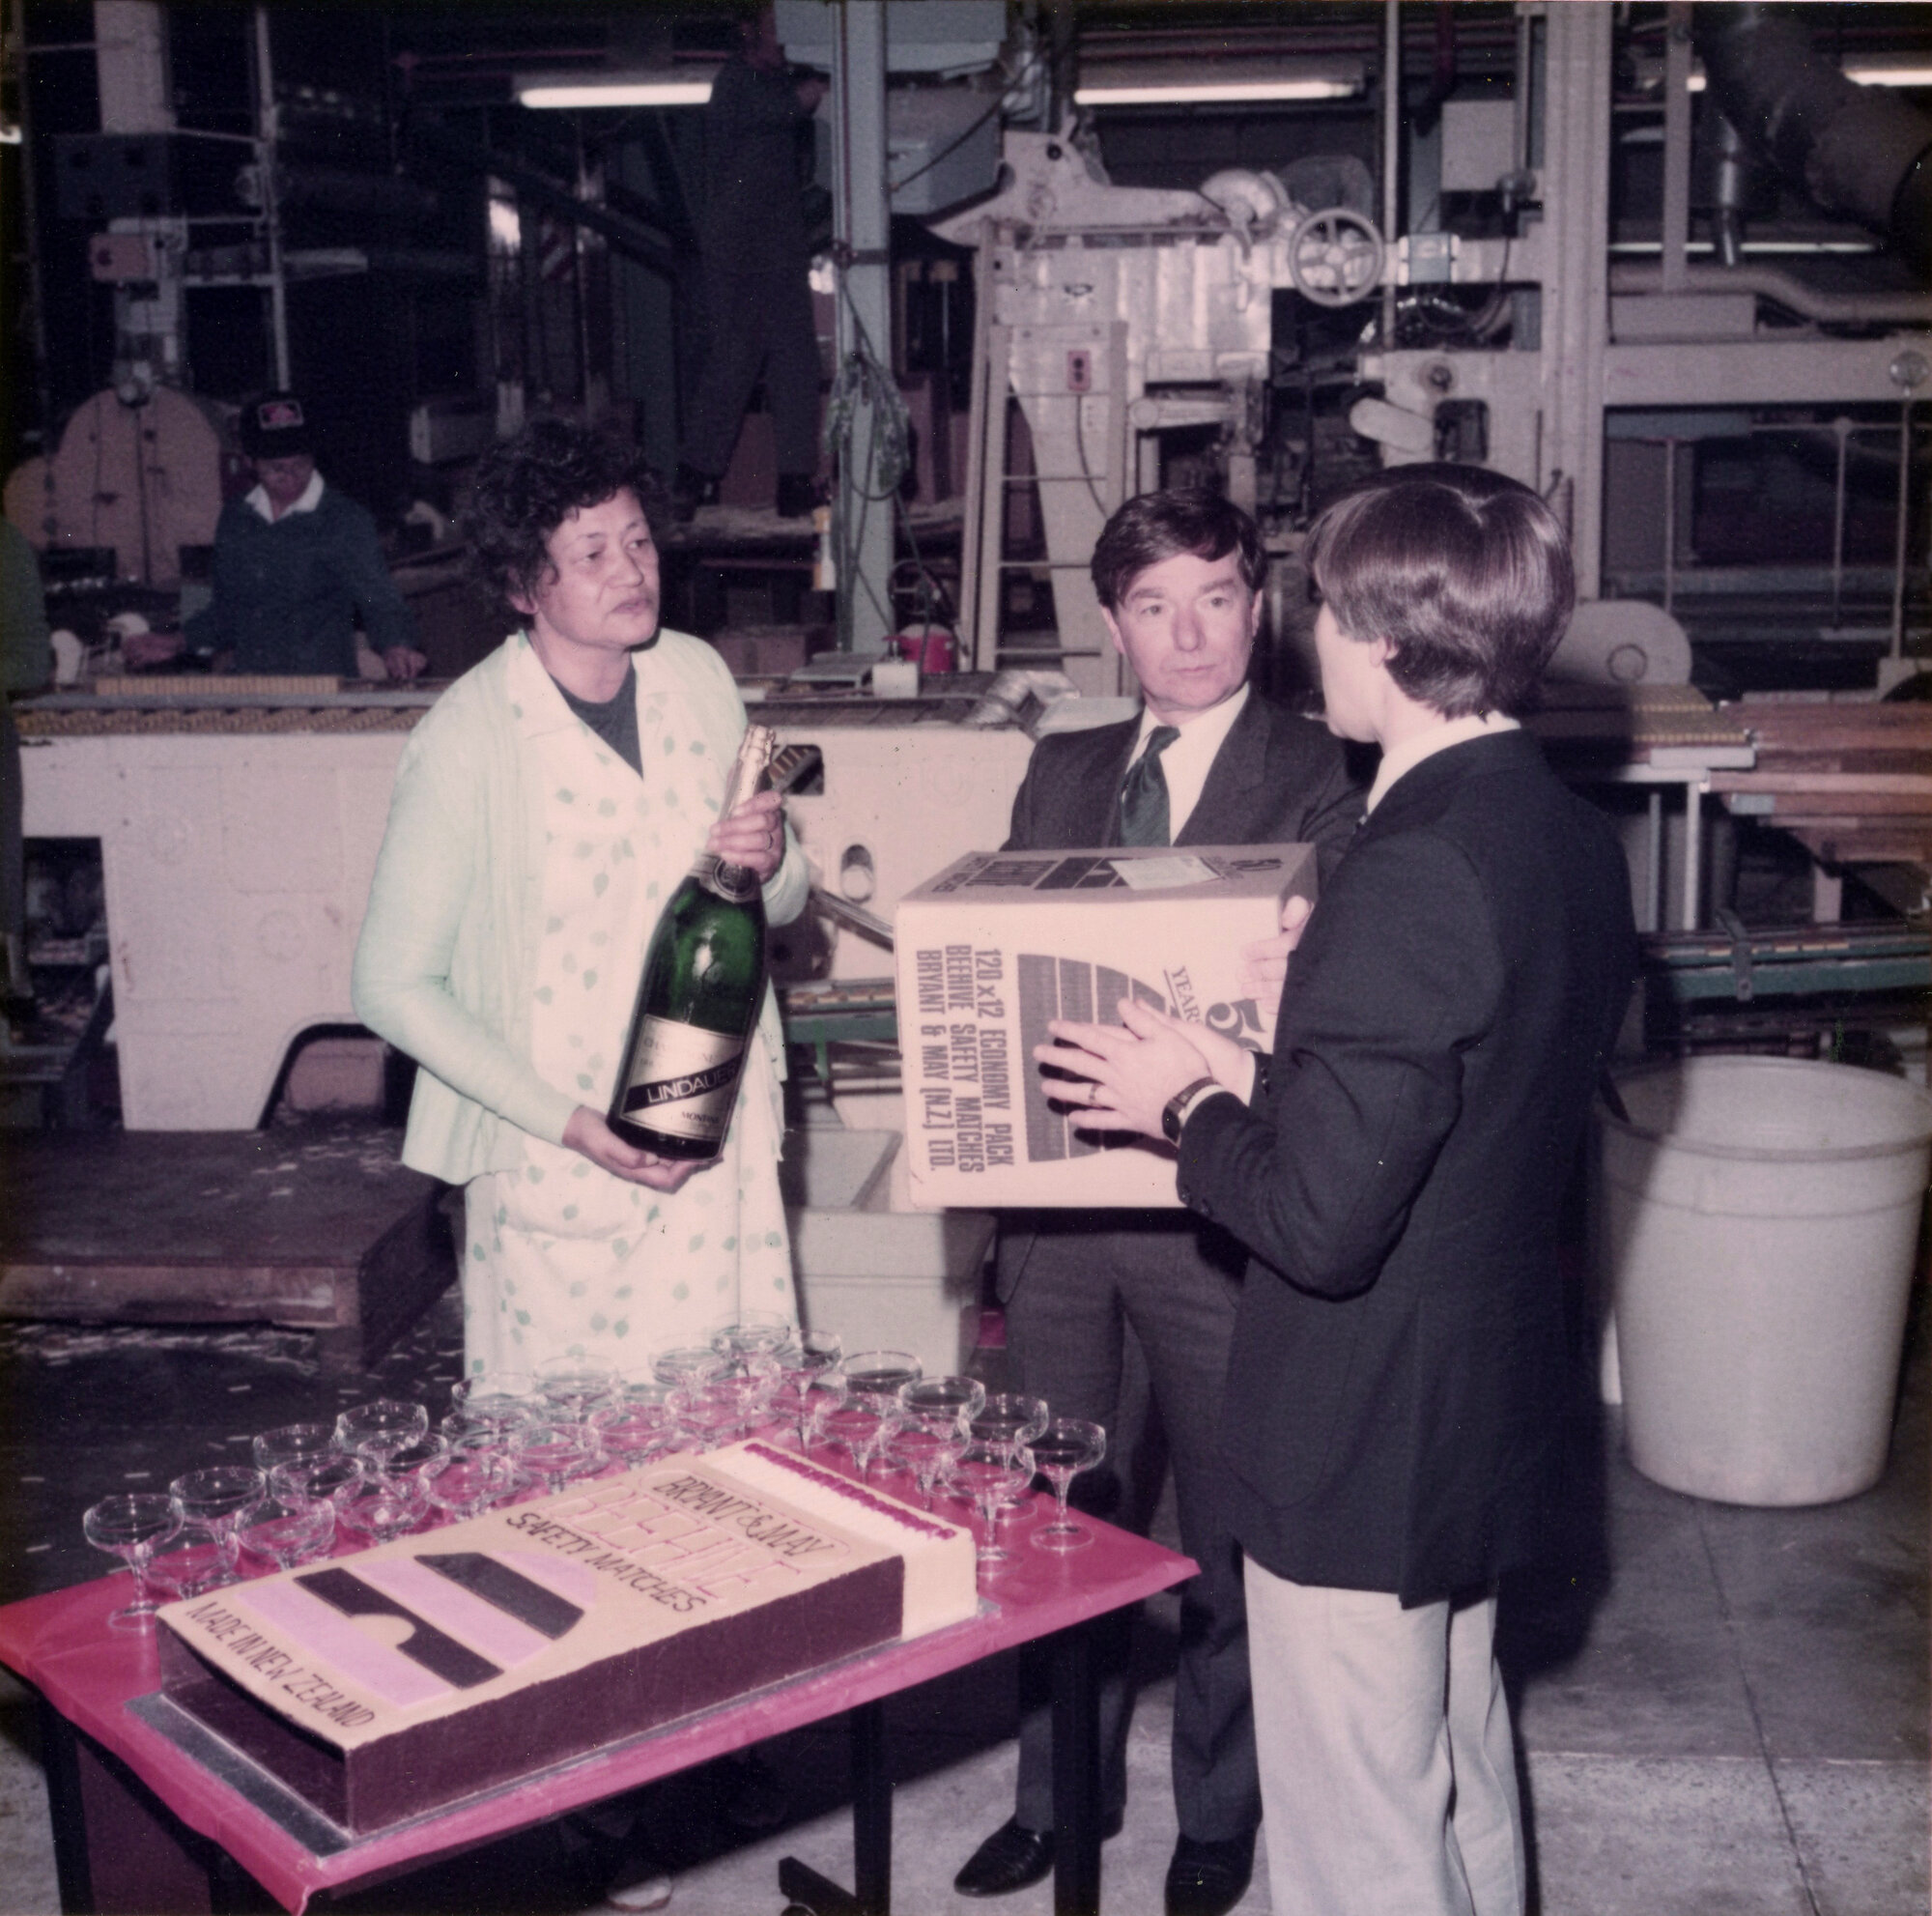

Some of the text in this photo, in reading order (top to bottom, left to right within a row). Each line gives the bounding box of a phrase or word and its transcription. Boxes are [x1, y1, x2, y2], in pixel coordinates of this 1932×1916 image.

[916, 950, 946, 1015] BRYANT
[921, 1025, 947, 1038] &
[922, 1045, 951, 1080] MAY
[945, 945, 985, 1173] BEEHIVE SAFETY MATCHES
[980, 1029, 1010, 1110] ECONOMY
[928, 1140, 955, 1171] LTD.
[984, 1124, 1014, 1166] PACK
[652, 1475, 760, 1521] BRYANT
[757, 1523, 835, 1557] MAY
[506, 1512, 707, 1613] SAFETY MATCHES
[185, 1601, 376, 1728] MADE IN NEW ZEALAND
